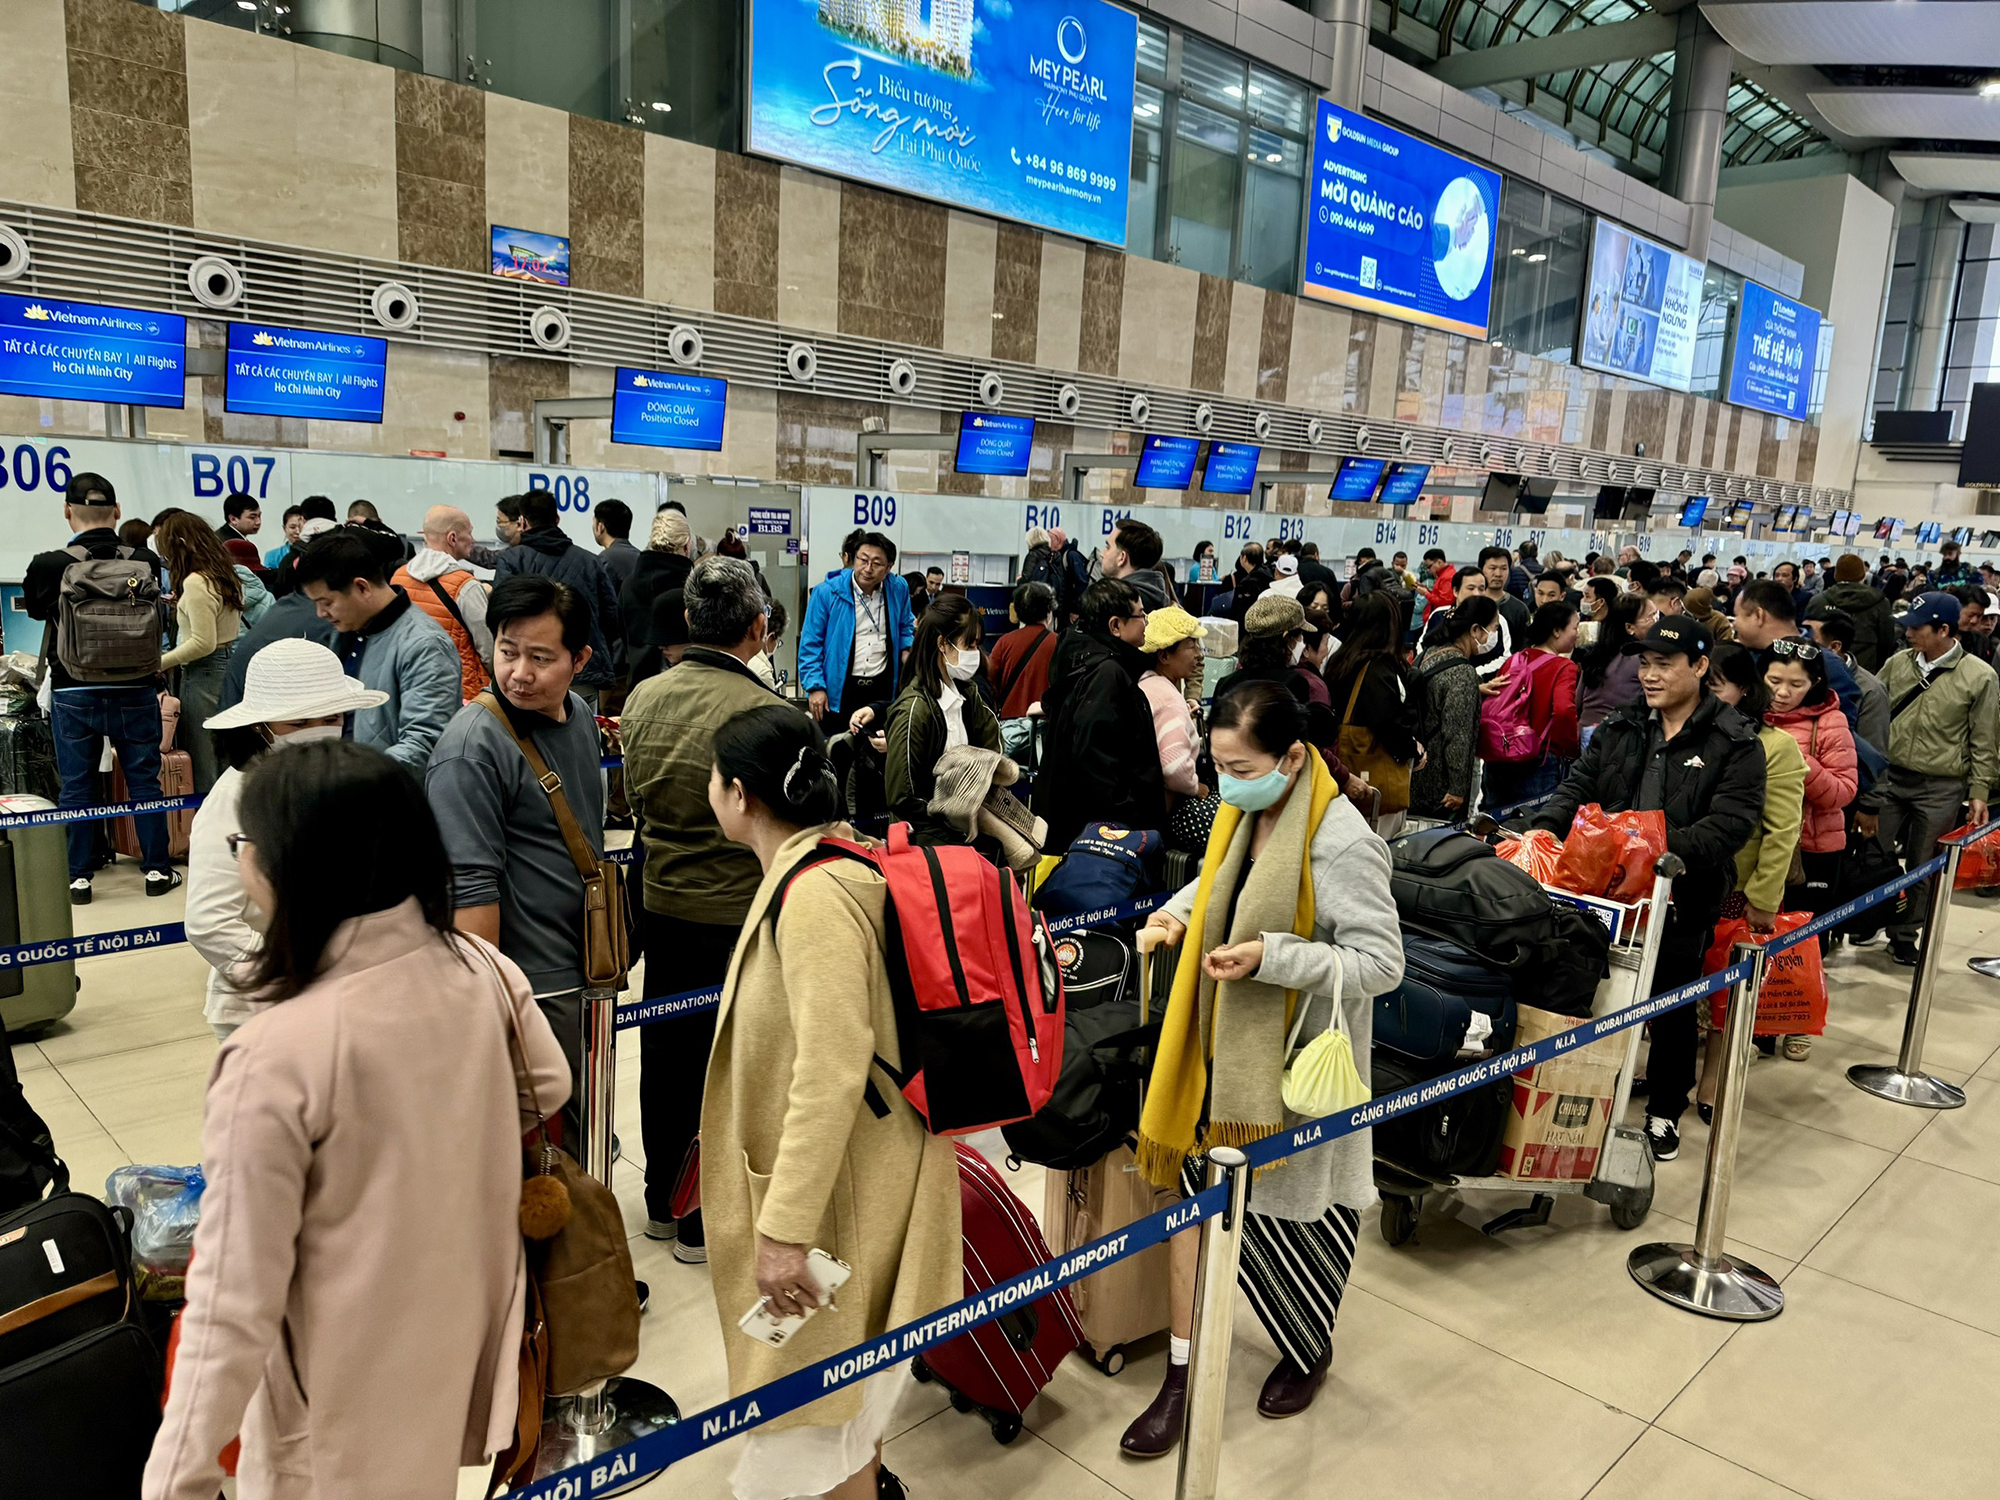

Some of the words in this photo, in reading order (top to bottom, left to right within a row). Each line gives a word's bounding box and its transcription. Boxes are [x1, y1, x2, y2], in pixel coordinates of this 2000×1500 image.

[1030, 54, 1060, 82] MEY
[1063, 65, 1108, 101] PEARL
[1026, 153, 1046, 171] +84
[1050, 159, 1064, 176] 96
[1067, 164, 1087, 183] 869
[1090, 171, 1117, 192] 9999
[1323, 159, 1367, 184] ADVERTISING
[1026, 175, 1102, 204] meypearlharmony.vn
[1321, 178, 1348, 205] MỜI
[1350, 190, 1395, 221] QUẢNG
[1398, 205, 1423, 230] CÁO
[49, 309, 99, 326] Vietnam
[100, 316, 143, 331] Airlines
[40, 343, 59, 358] CÁC
[104, 351, 122, 363] BAY
[134, 354, 145, 366] All
[148, 356, 177, 370] Flights
[273, 336, 315, 350] Vietnam
[315, 341, 350, 354] Airlines
[53, 361, 66, 373] Ho
[69, 363, 85, 375] Chi
[87, 365, 112, 378] Minh
[114, 368, 133, 382] City
[317, 372, 333, 383] BAY
[342, 375, 352, 385] All
[353, 377, 378, 389] Flights
[274, 382, 286, 393] Ho
[303, 385, 324, 396] Minh
[325, 387, 342, 400] City
[641, 412, 672, 424] Position
[674, 415, 699, 427] Closed
[0, 444, 73, 493] 06
[191, 453, 276, 499] B07
[853, 493, 897, 527] B09
[1026, 504, 1061, 536] B10
[1225, 515, 1251, 539] B12
[1280, 518, 1304, 541] B13
[1376, 522, 1396, 544] B14
[1418, 525, 1439, 546] B15
[1495, 528, 1512, 548] B16
[32, 804, 132, 823] INTERNATIONAL
[135, 797, 185, 812] AIRPORT
[1049, 916, 1073, 933] QUỐC
[1075, 911, 1087, 926] TẾ
[1087, 912, 1101, 924] NỘI
[1135, 899, 1153, 911] N.I.A
[17, 942, 68, 963] QUỐC
[73, 936, 95, 955] TẾ
[99, 935, 129, 951] NỘI
[134, 930, 160, 945] BÀI
[1293, 1124, 1322, 1147] N.I.A
[1350, 1105, 1384, 1126] CẢNG
[1386, 1092, 1418, 1114] HÀNG
[1420, 1076, 1456, 1103] KHÔNG
[1458, 1064, 1487, 1088] QUỐC
[1489, 1056, 1502, 1077] TẾ
[1502, 1053, 1519, 1072] NỘI
[1521, 1048, 1536, 1065] BÀI
[1555, 1033, 1576, 1050] N.I.A
[1595, 1014, 1623, 1035] NOIBAI
[1624, 995, 1680, 1024] INTERNATIONAL
[1681, 980, 1710, 1000] AIRPORT
[1725, 969, 1740, 984] N.I.A
[1558, 1102, 1589, 1117] CHIN-SU
[590, 1452, 637, 1491] BÀI
[702, 1400, 761, 1440] N.I.A
[822, 1342, 897, 1388] NOIBAI
[903, 1274, 1053, 1354] INTERNATIONAL
[1057, 1234, 1129, 1279] AIRPORT
[1165, 1202, 1201, 1231] N.I.A
